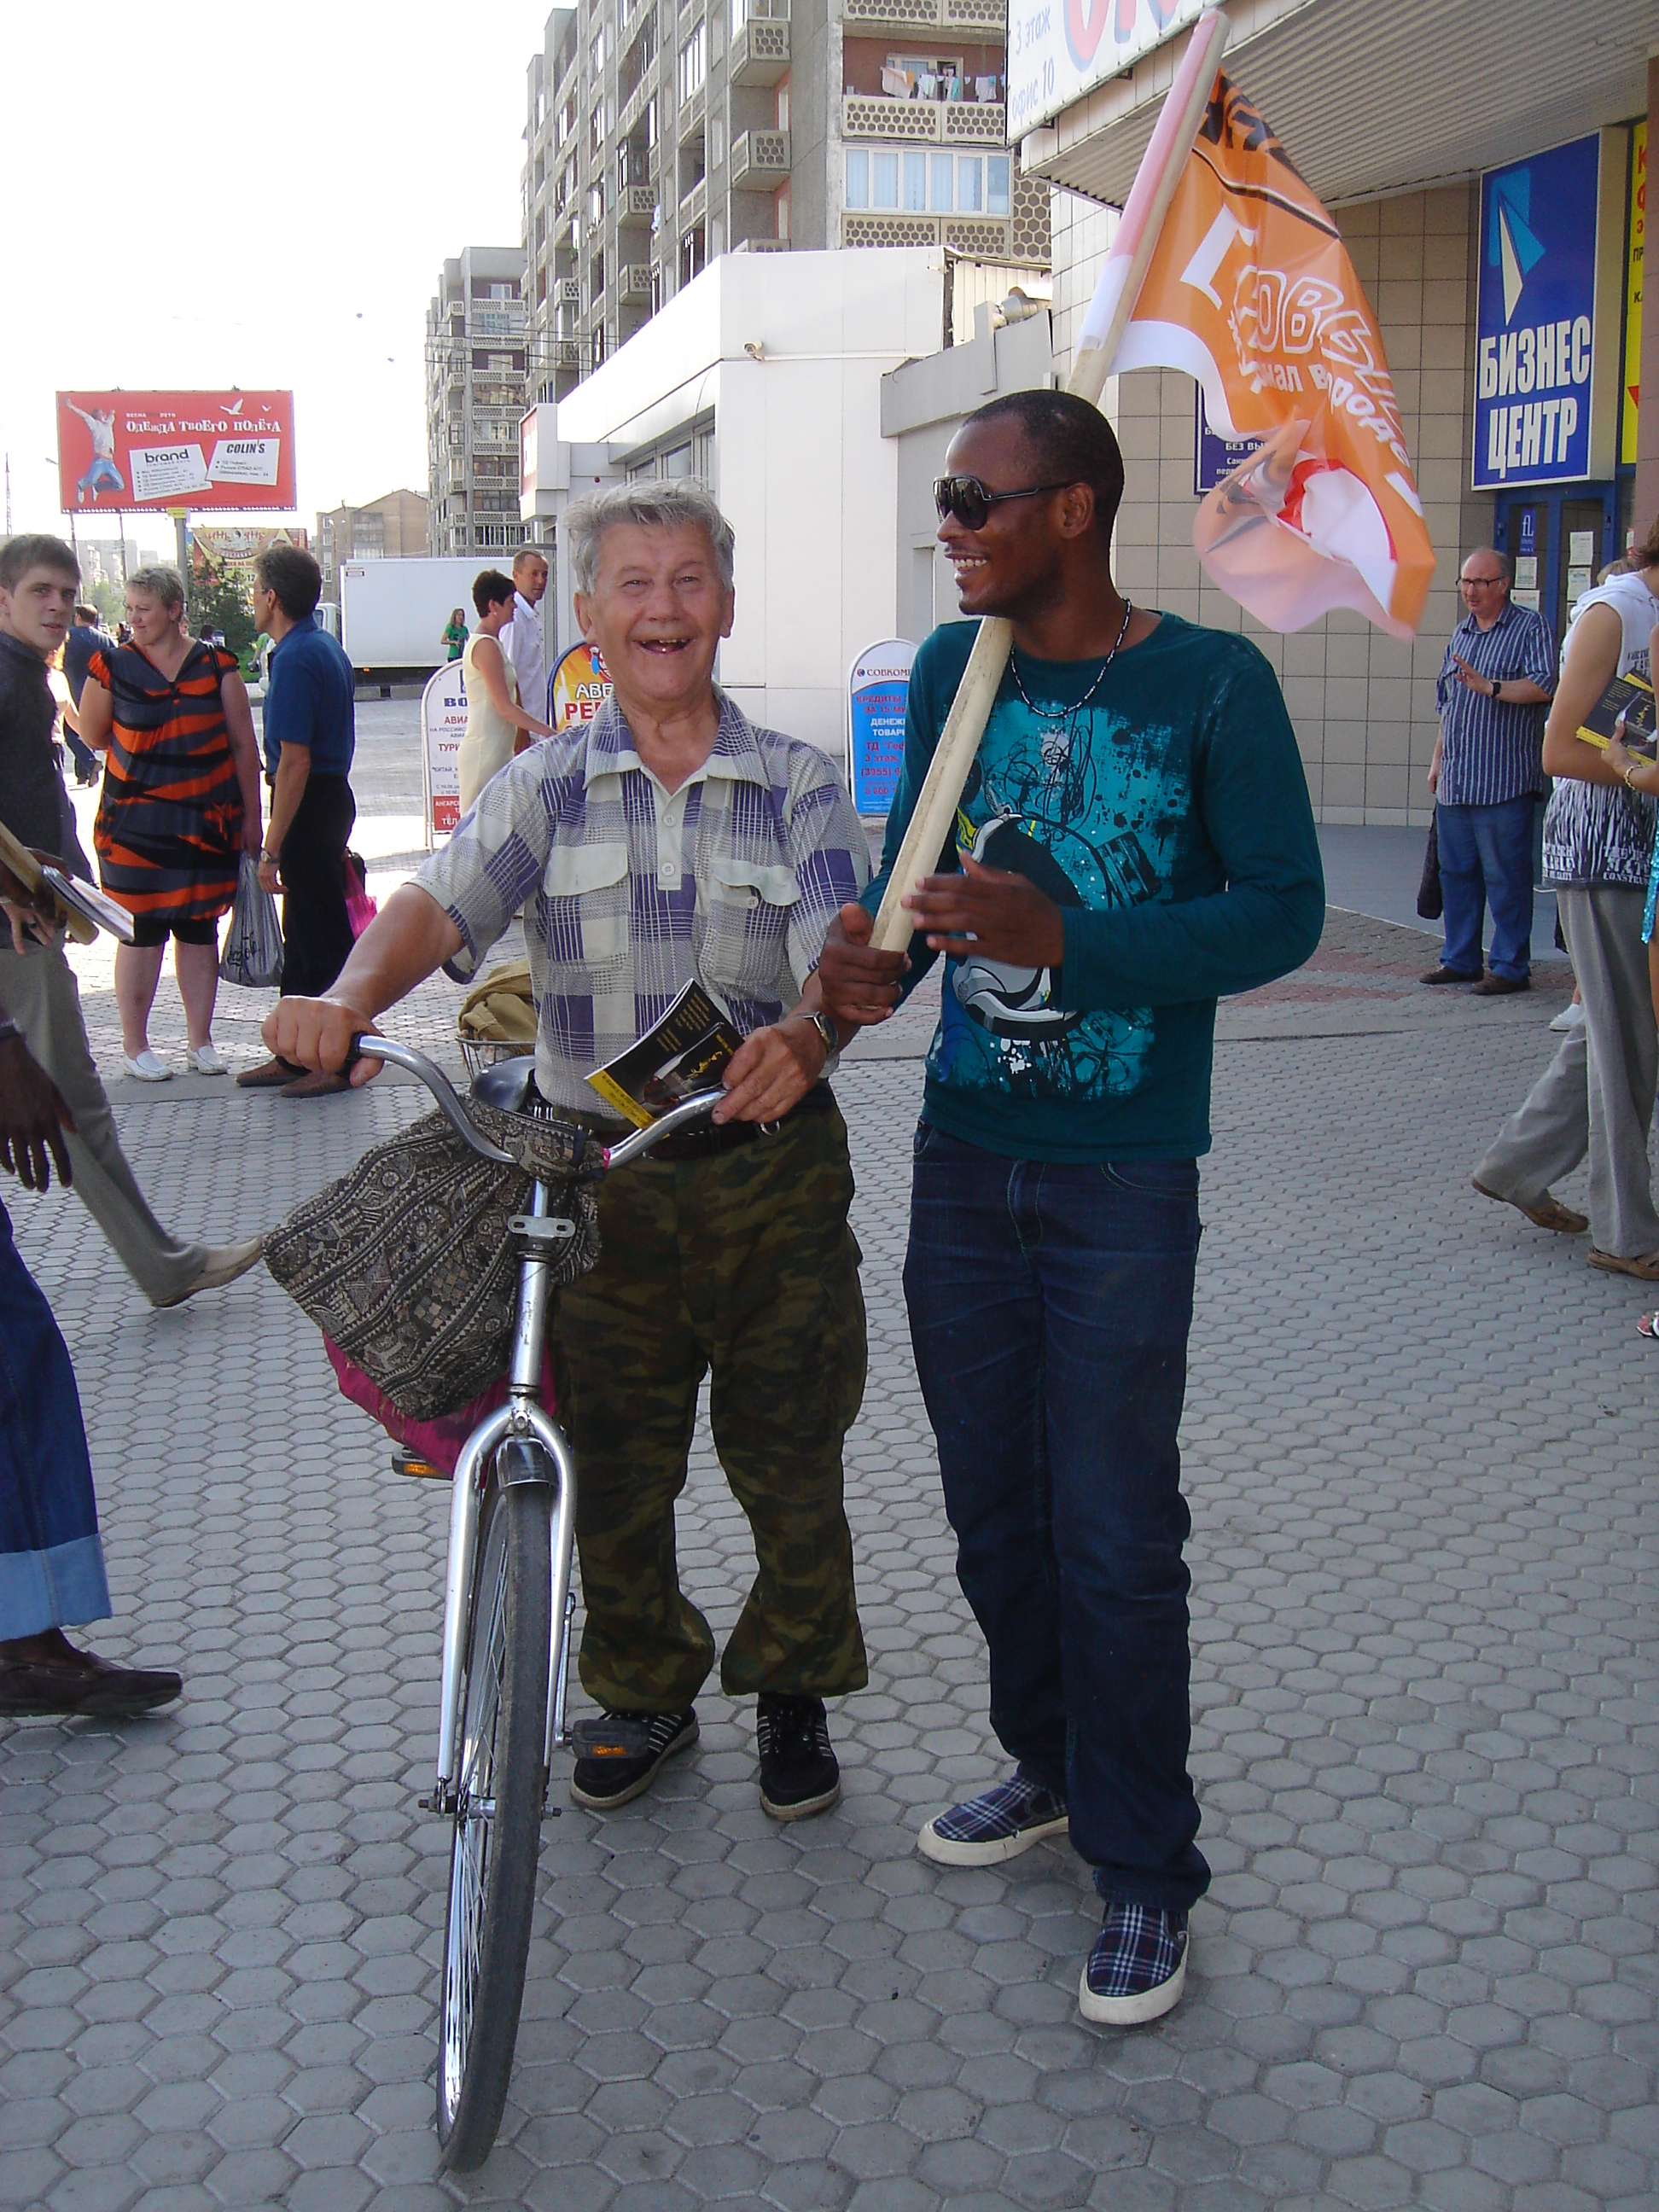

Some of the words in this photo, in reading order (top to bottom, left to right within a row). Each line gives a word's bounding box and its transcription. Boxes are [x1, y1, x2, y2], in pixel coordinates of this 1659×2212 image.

[1024, 4, 1052, 51] этаж
[1011, 76, 1039, 124] офис
[1042, 56, 1056, 99] 10
[1478, 315, 1592, 401] БИЗНЕС
[144, 448, 189, 463] brand
[226, 441, 265, 454] COLIN'S
[1225, 442, 1244, 451] БЕЗ
[1487, 397, 1579, 480] ЦЕНТР
